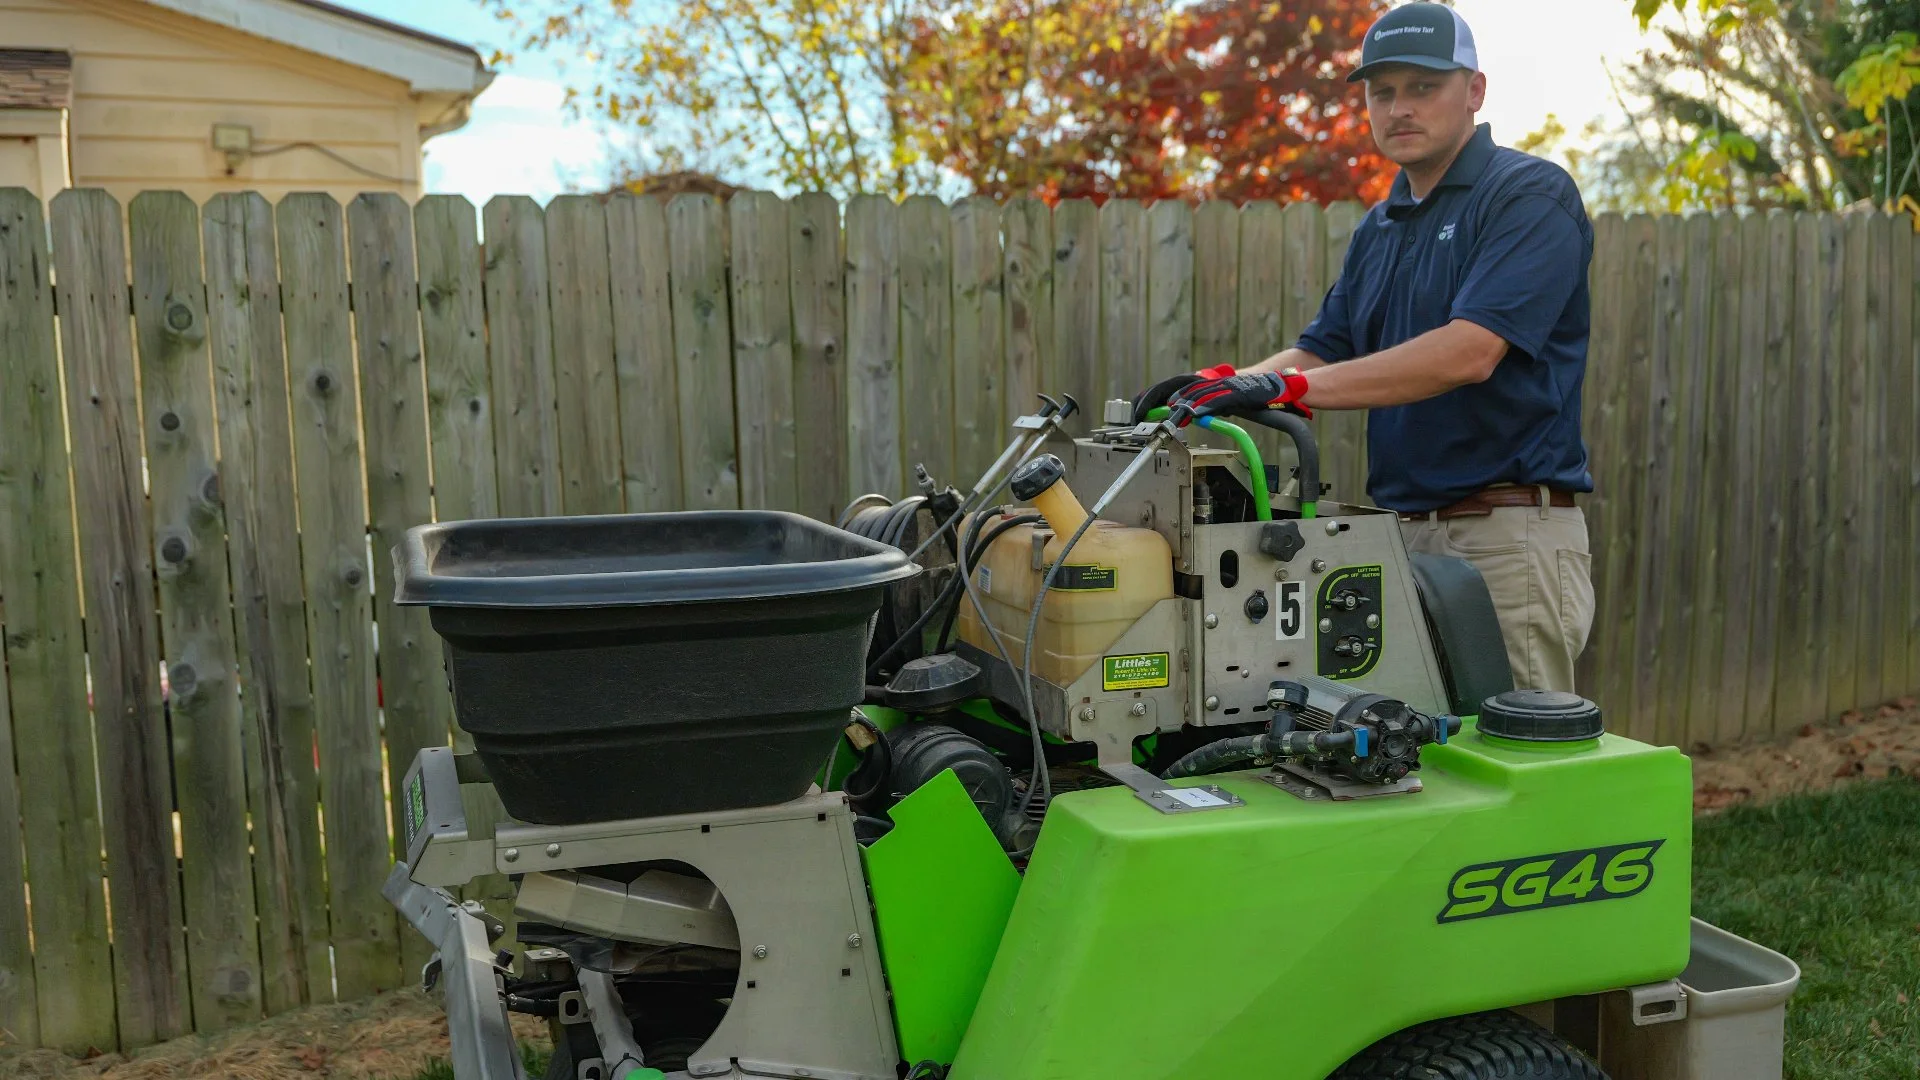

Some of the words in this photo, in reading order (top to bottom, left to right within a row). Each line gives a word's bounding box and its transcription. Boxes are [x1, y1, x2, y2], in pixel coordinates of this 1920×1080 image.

[1422, 26, 1434, 34] Turf
[1280, 582, 1301, 637] 5
[1115, 656, 1151, 668] Little's
[1443, 846, 1654, 918] SG46
